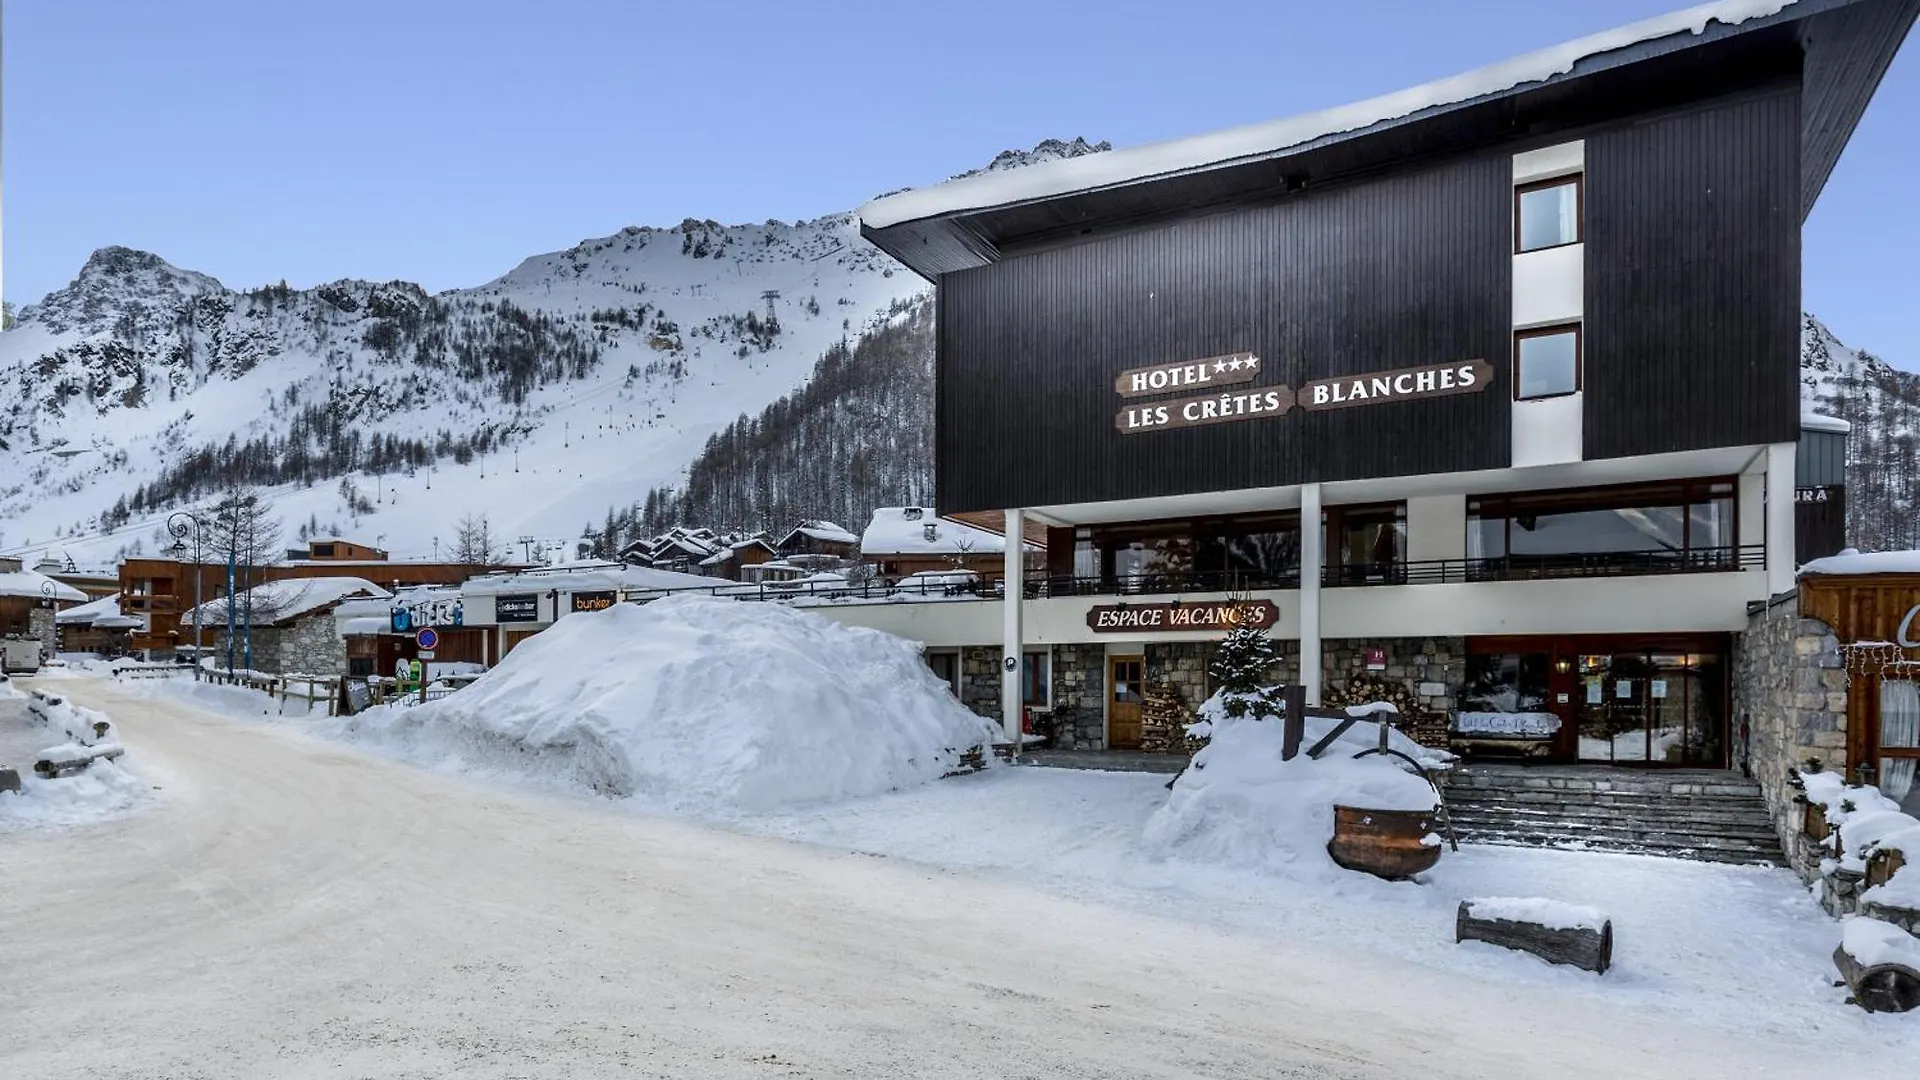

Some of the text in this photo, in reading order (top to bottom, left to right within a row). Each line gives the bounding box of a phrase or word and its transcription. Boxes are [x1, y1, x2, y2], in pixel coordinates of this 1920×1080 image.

[1131, 363, 1211, 392] HOTEL
[1127, 365, 1476, 429] LES CRÊTES BLANCHES
[1096, 608, 1163, 627] ESPACE
